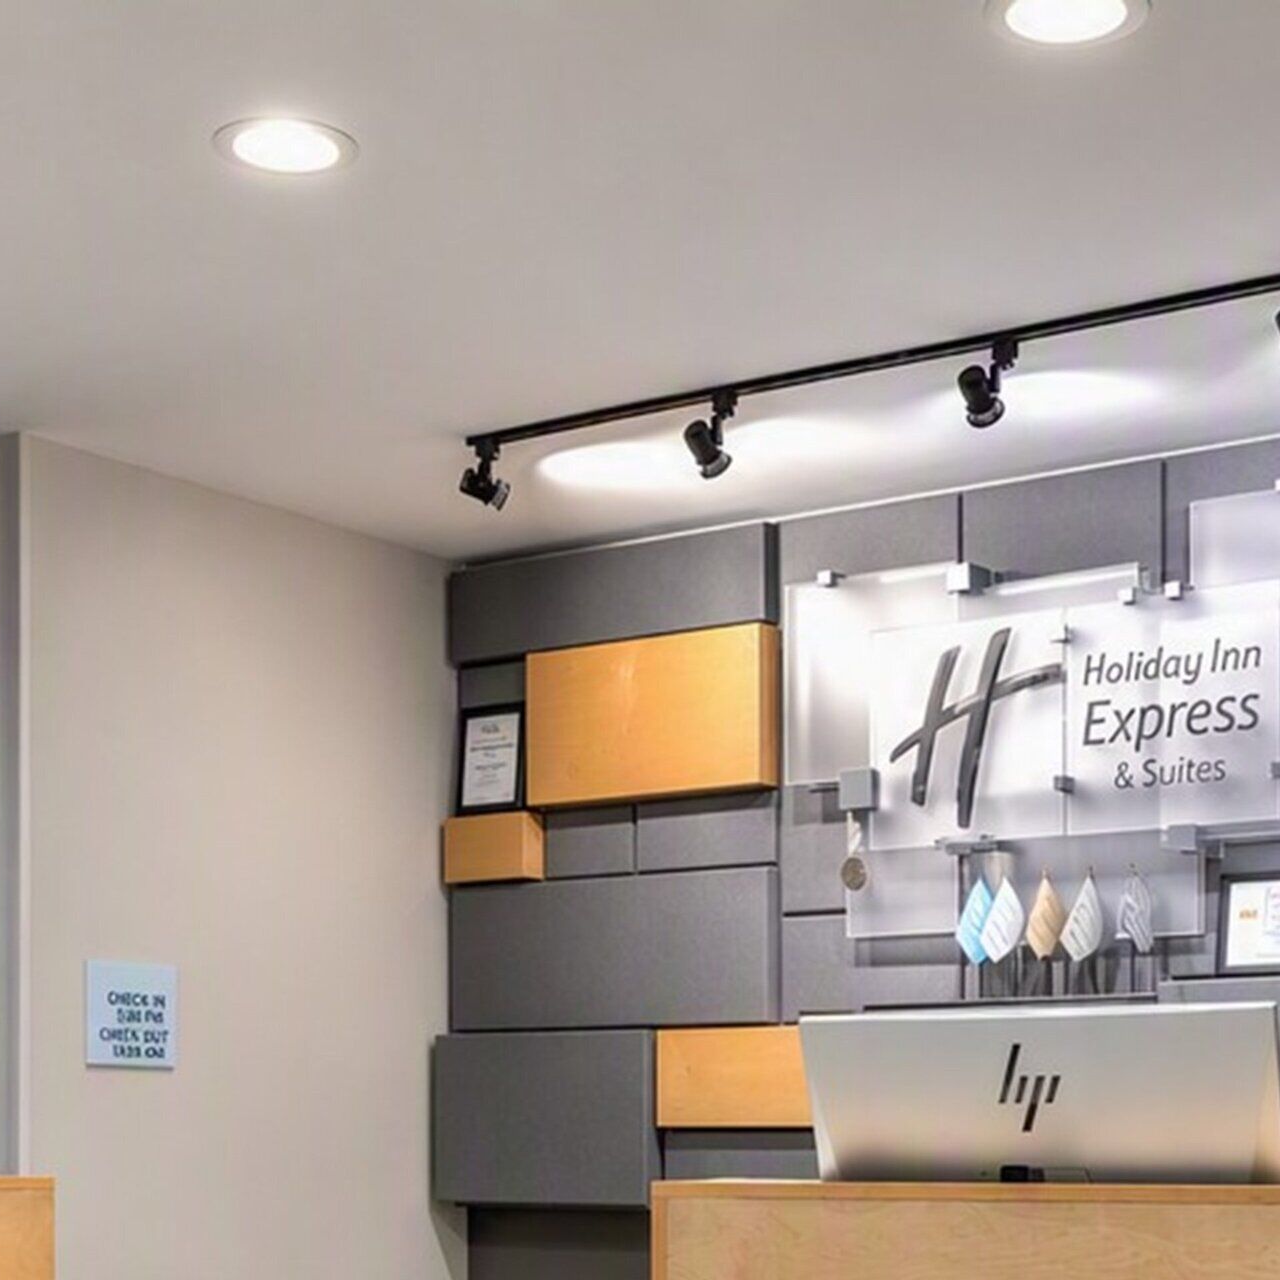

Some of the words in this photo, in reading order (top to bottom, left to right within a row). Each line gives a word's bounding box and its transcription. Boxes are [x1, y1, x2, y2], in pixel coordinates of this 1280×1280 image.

[1083, 646, 1203, 686] Holiday
[1211, 637, 1262, 673] Inn
[1083, 693, 1260, 752] Express
[1114, 761, 1134, 789] &
[1142, 757, 1226, 788] Suites
